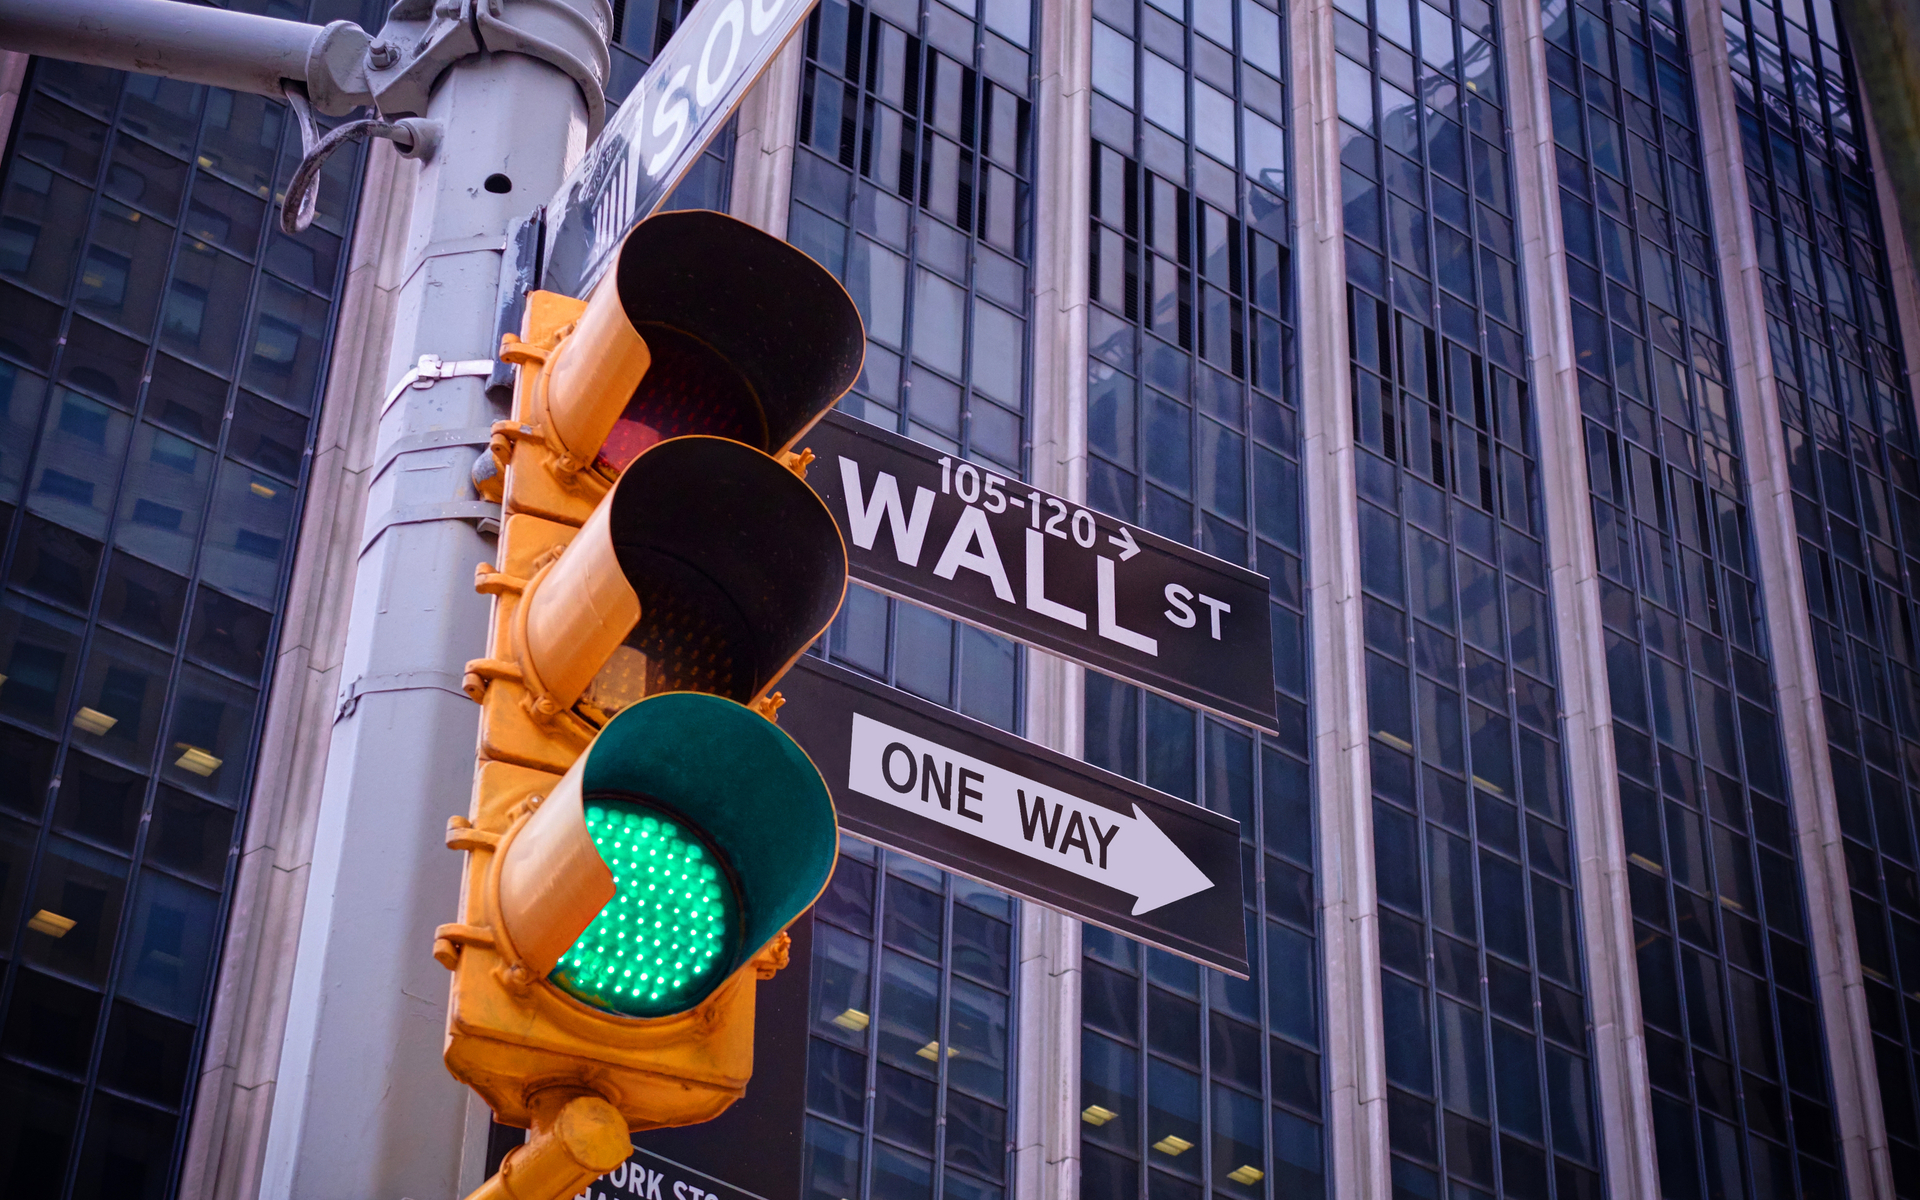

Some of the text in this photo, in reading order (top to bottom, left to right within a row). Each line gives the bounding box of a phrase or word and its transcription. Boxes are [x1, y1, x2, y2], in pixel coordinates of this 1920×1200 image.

[838, 455, 1231, 657] WALL ST
[937, 456, 1096, 549] 105-120
[882, 742, 1120, 869] ONE WAY
[598, 1161, 664, 1200] ORK
